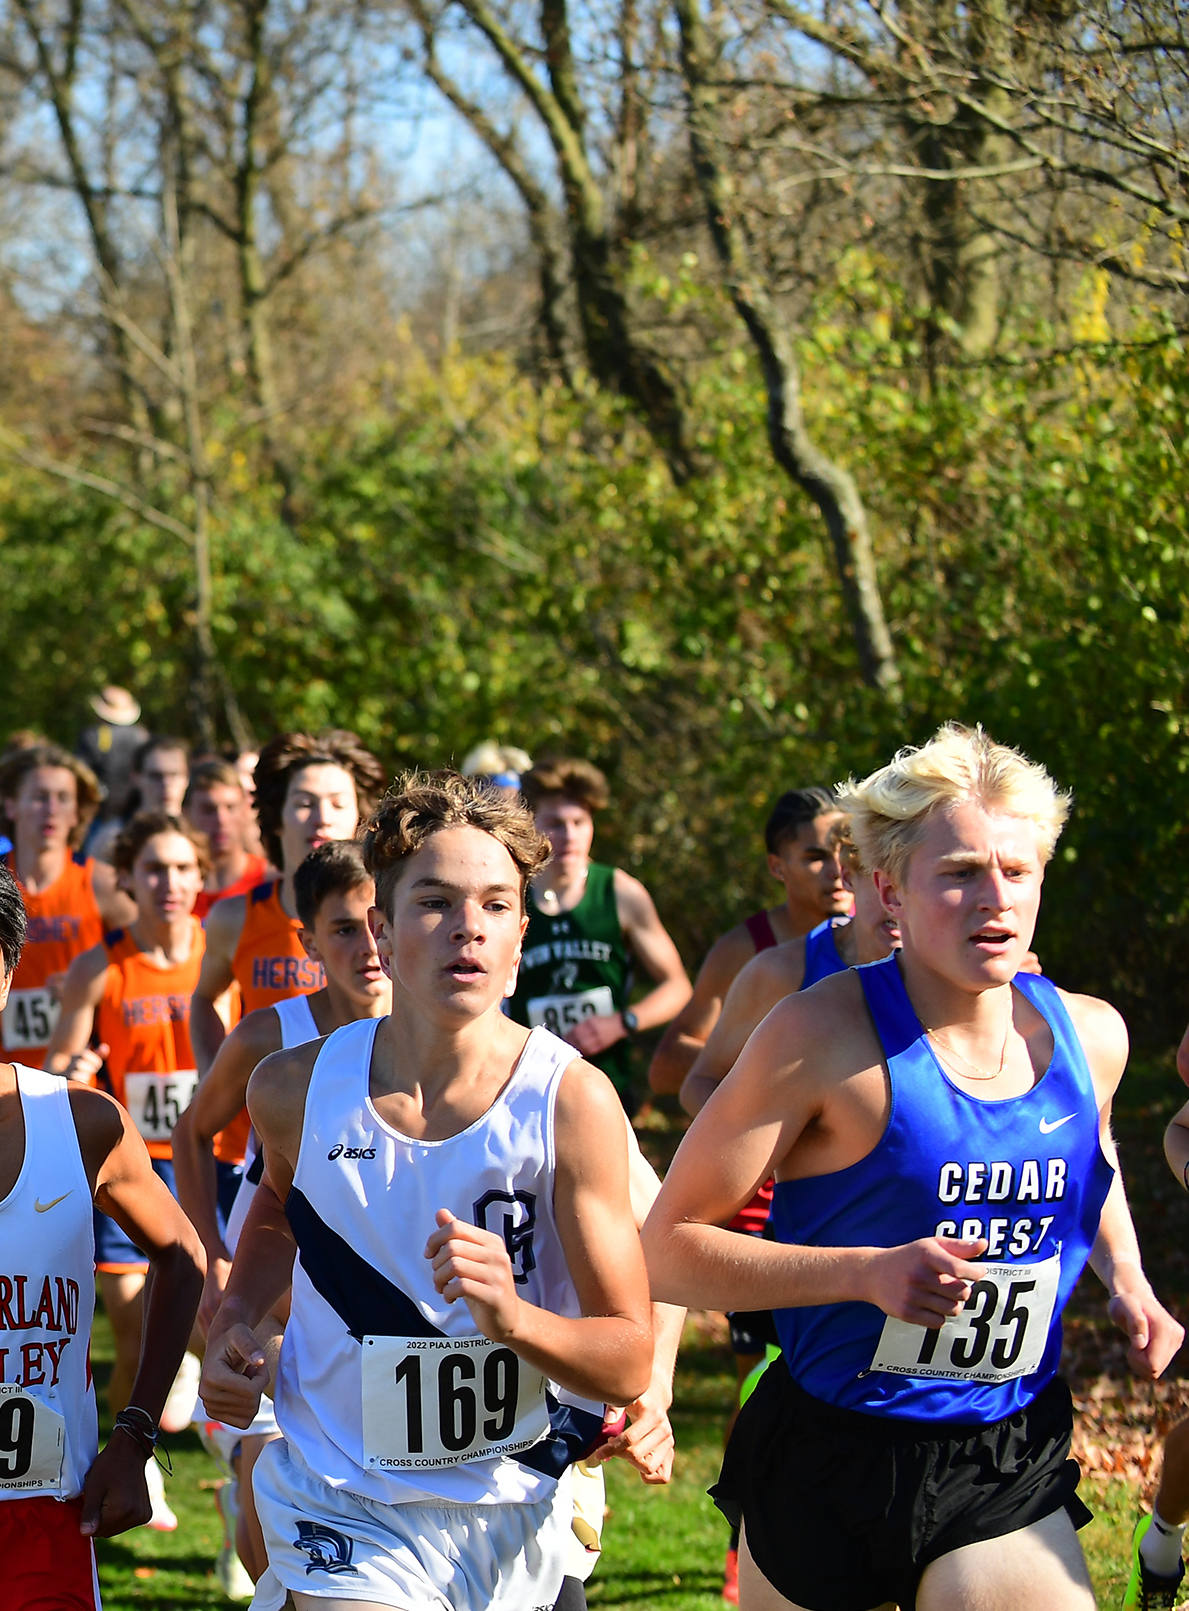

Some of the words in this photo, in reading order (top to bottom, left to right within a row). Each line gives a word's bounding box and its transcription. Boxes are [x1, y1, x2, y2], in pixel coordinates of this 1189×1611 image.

[553, 940, 611, 962] VALLEY
[14, 996, 58, 1040] 45
[144, 1083, 198, 1130] 45
[343, 1147, 376, 1159] asics
[938, 1158, 1068, 1206] CEDAR
[985, 1267, 1024, 1277] DISTRICT
[406, 1341, 427, 1349] 2022
[429, 1341, 452, 1349] PIAA
[886, 1365, 918, 1375] CROSS
[919, 1368, 963, 1379] COUNTRY
[963, 1368, 1026, 1381] CHAMPIONSHIPS
[15, 1386, 23, 1394] III
[395, 1347, 519, 1453] 169
[380, 1458, 412, 1467] CROSS
[414, 1456, 460, 1467] COUNTRY
[461, 1439, 534, 1461] CHAMPIONSHIPS
